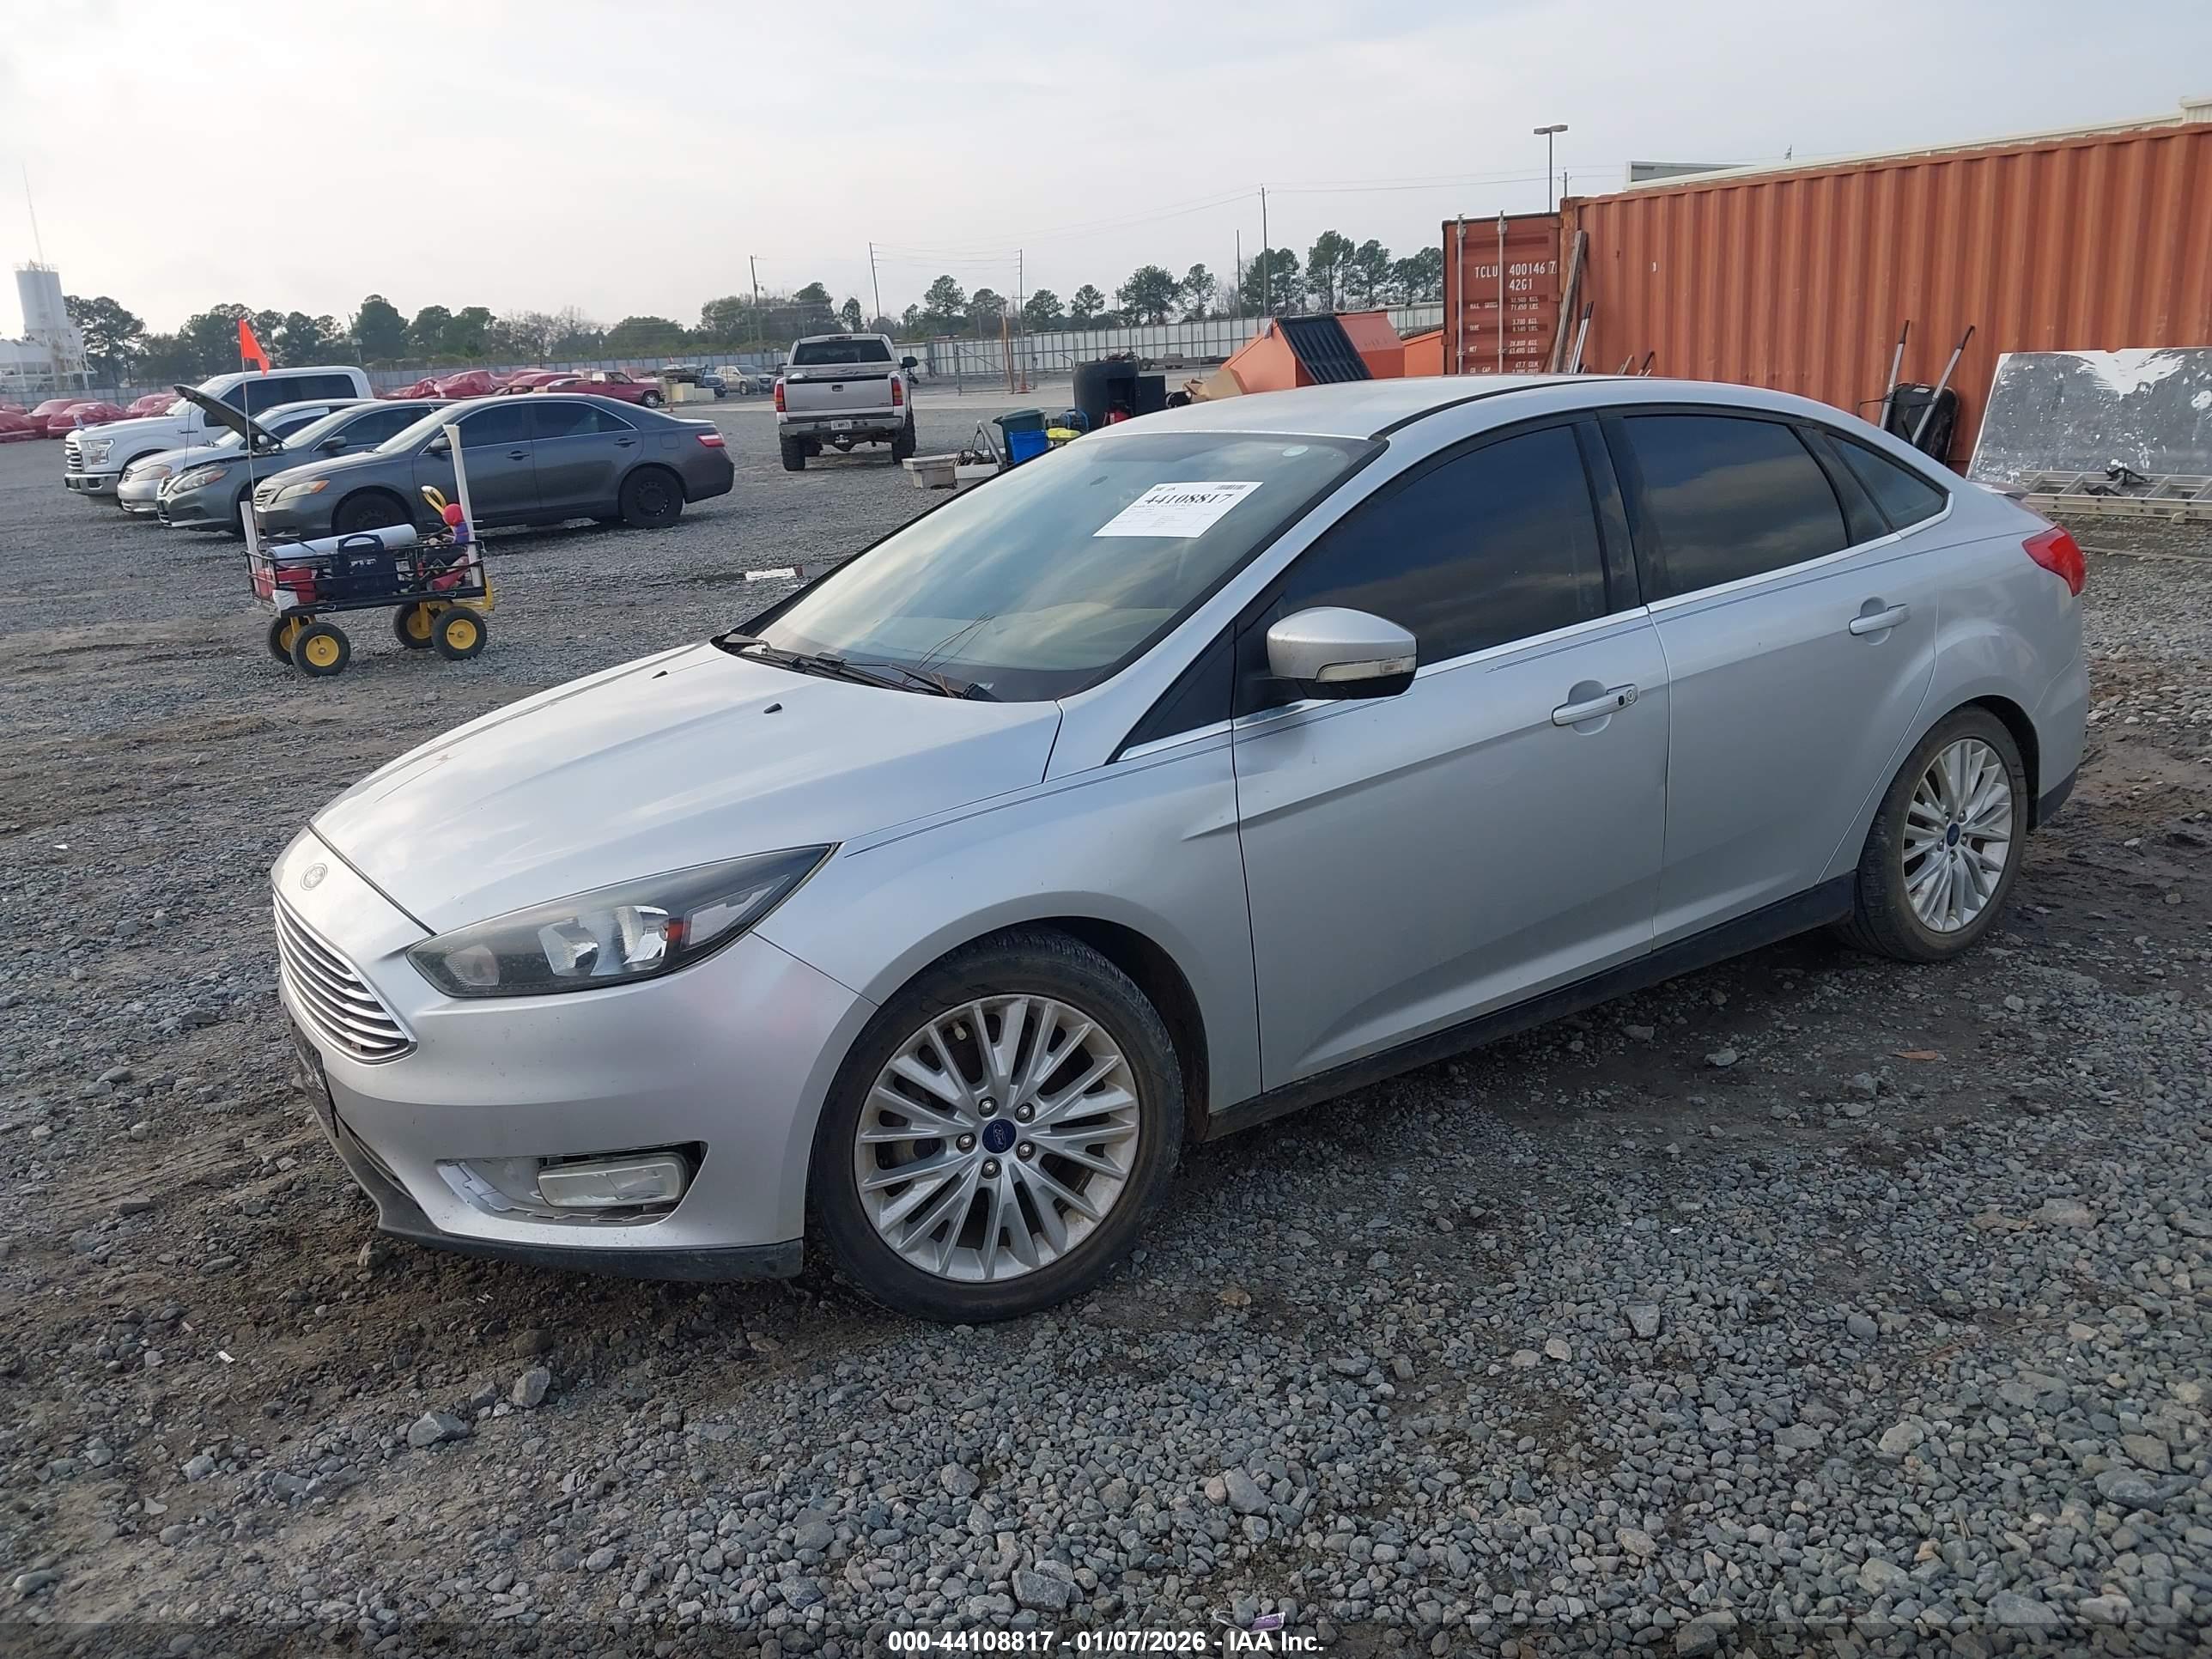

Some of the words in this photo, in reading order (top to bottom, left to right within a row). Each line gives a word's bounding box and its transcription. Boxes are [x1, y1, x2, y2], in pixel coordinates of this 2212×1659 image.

[1474, 265, 1498, 278] TCLU
[1509, 262, 1546, 276] 400146
[1509, 278, 1533, 290] 42G1
[1145, 494, 1235, 504] 44108817
